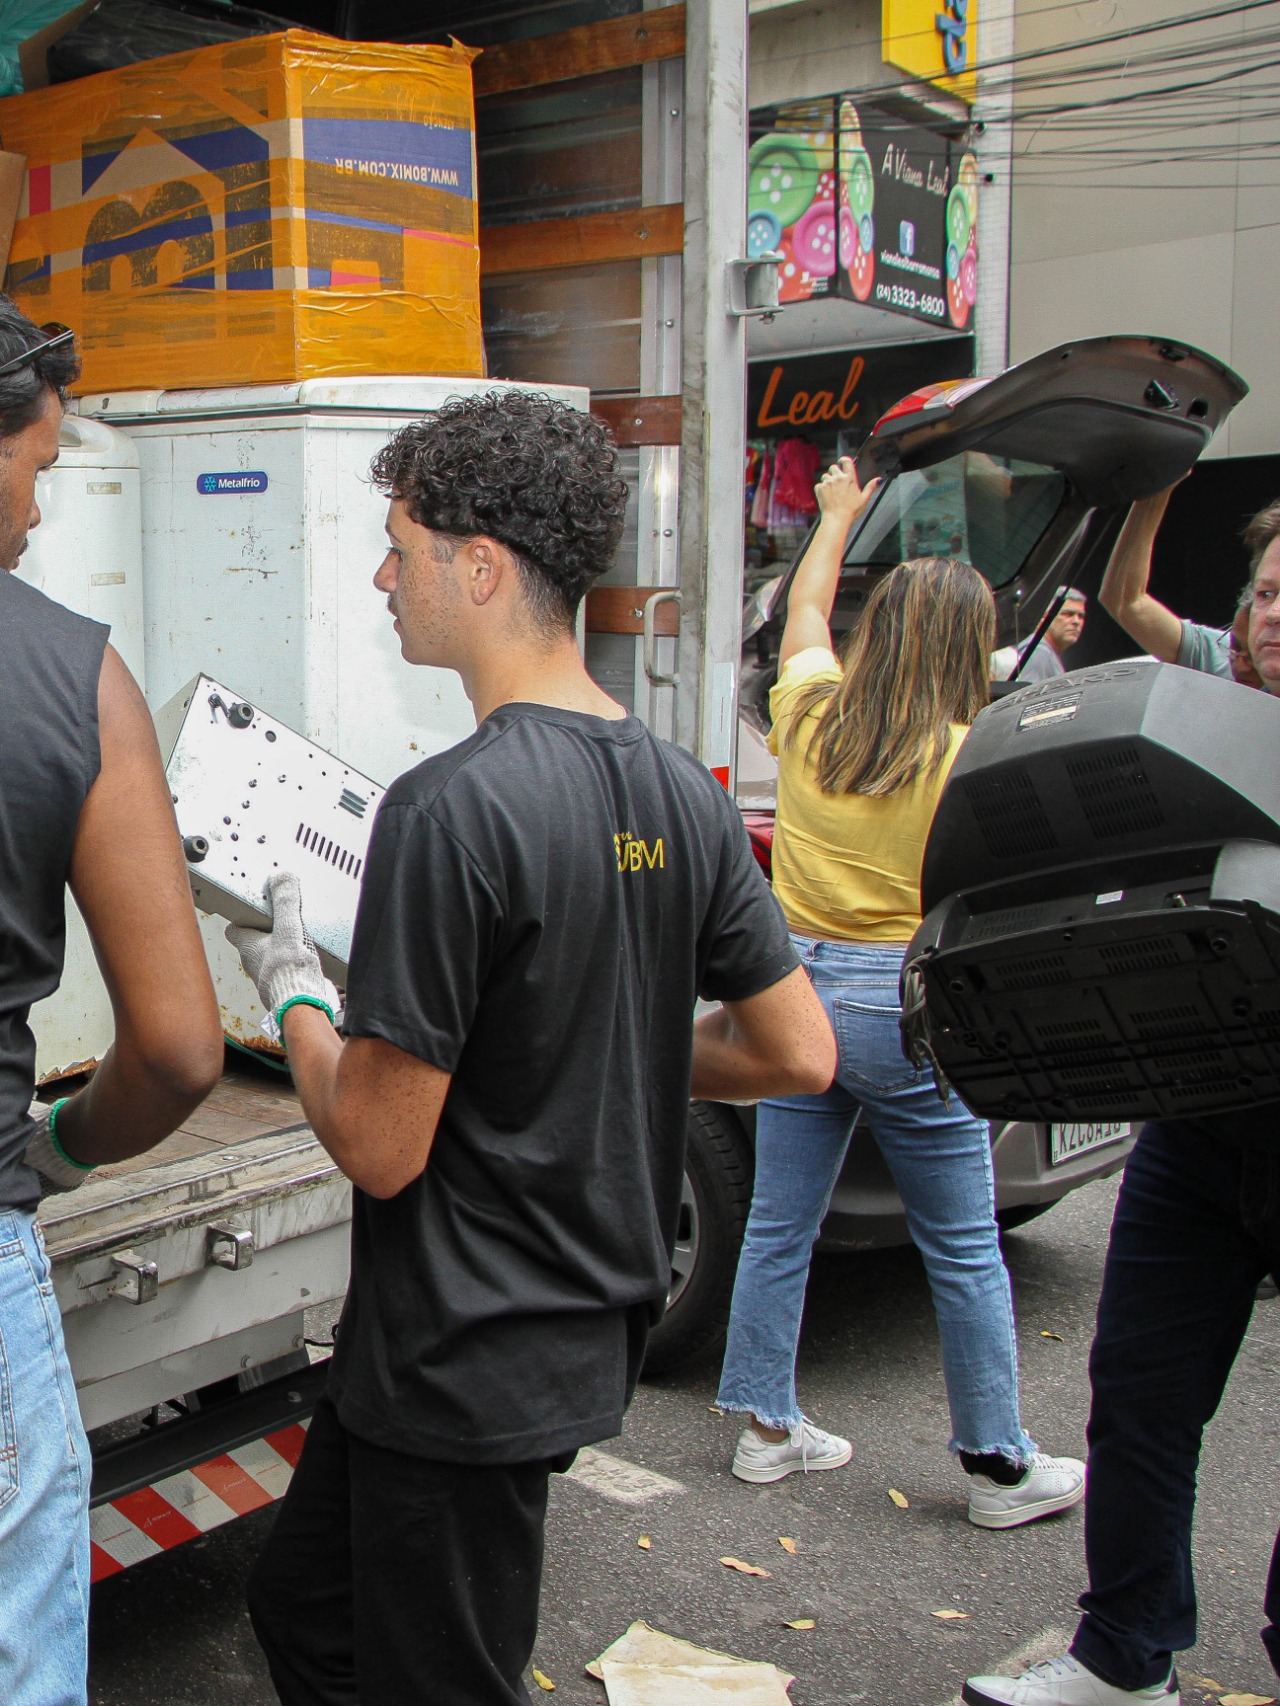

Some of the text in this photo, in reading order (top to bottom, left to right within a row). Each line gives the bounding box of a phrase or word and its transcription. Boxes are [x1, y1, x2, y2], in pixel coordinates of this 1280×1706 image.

[335, 159, 458, 187] WWW.BOMIX.COM.BR
[881, 143, 894, 175] A
[926, 160, 950, 197] Leal
[876, 283, 945, 317] (24) 3323-6800
[757, 356, 865, 427] Leal
[218, 478, 260, 488] Metalfrio
